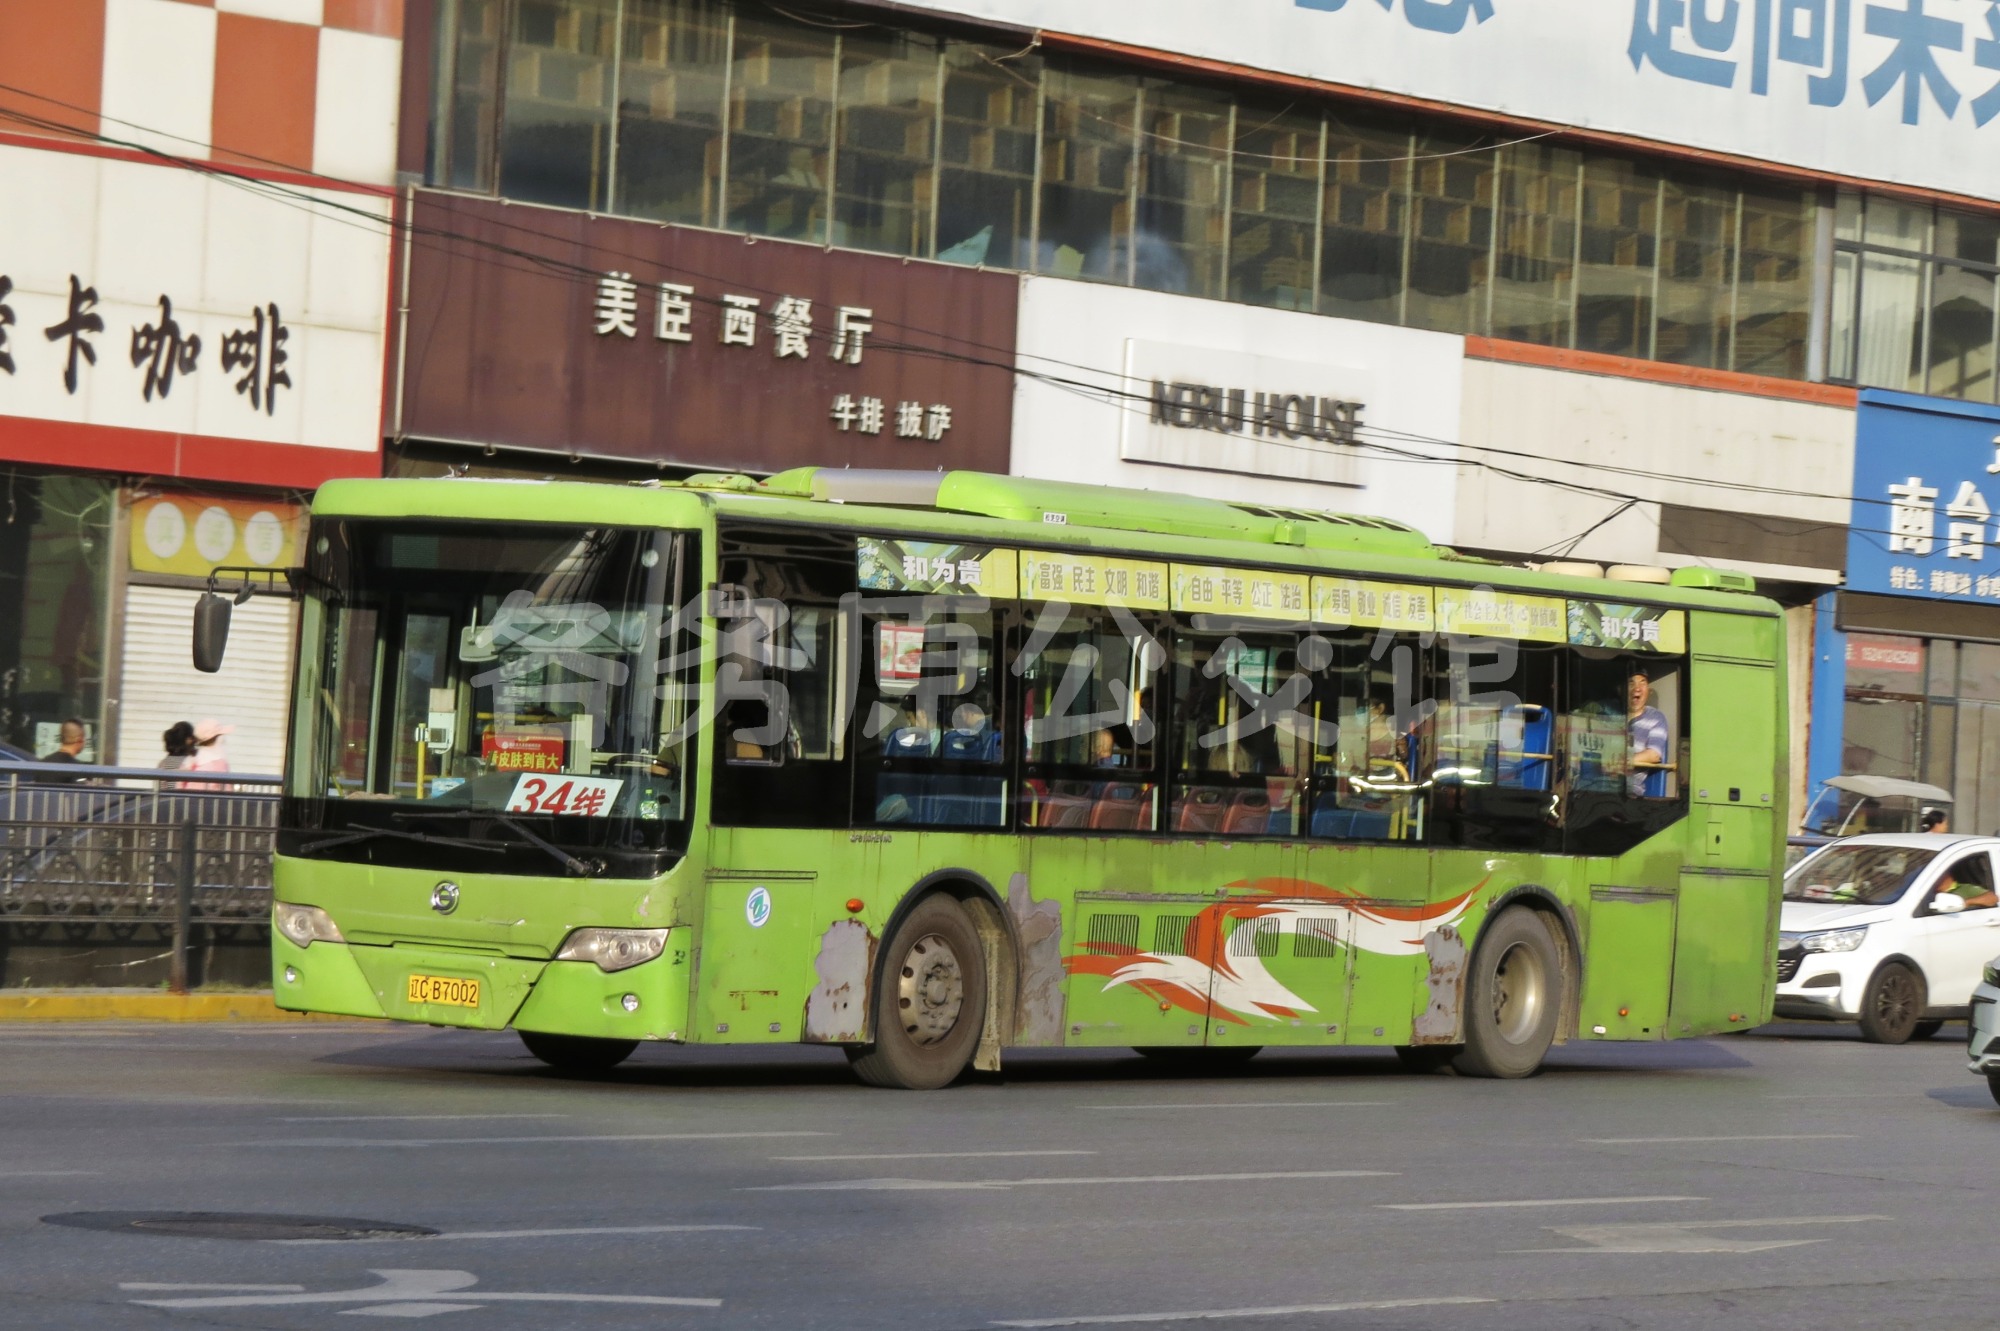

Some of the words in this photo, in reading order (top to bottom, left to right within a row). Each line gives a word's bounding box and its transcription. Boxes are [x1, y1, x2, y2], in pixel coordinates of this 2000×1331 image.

[594, 270, 873, 364] 美臣西餐厅
[831, 394, 885, 434] 牛排
[896, 401, 952, 440] 披萨
[1253, 391, 1366, 446] HOUSE
[1888, 477, 2000, 561] 南台
[903, 555, 982, 585] 和为贵
[1039, 562, 1063, 591] 富强
[1072, 566, 1095, 593] 民主
[1104, 569, 1127, 596] 文明
[1136, 571, 1159, 598] 和谐
[1191, 576, 1213, 602] 自由
[1221, 579, 1243, 605] 平等
[1251, 582, 1272, 607] 公正
[1280, 584, 1301, 609] 法治
[1332, 588, 1350, 614] 爱国
[1357, 591, 1376, 616] 敬业
[1408, 595, 1426, 621] 友善
[1602, 616, 1660, 641] 和为贵
[513, 778, 606, 815] 34线
